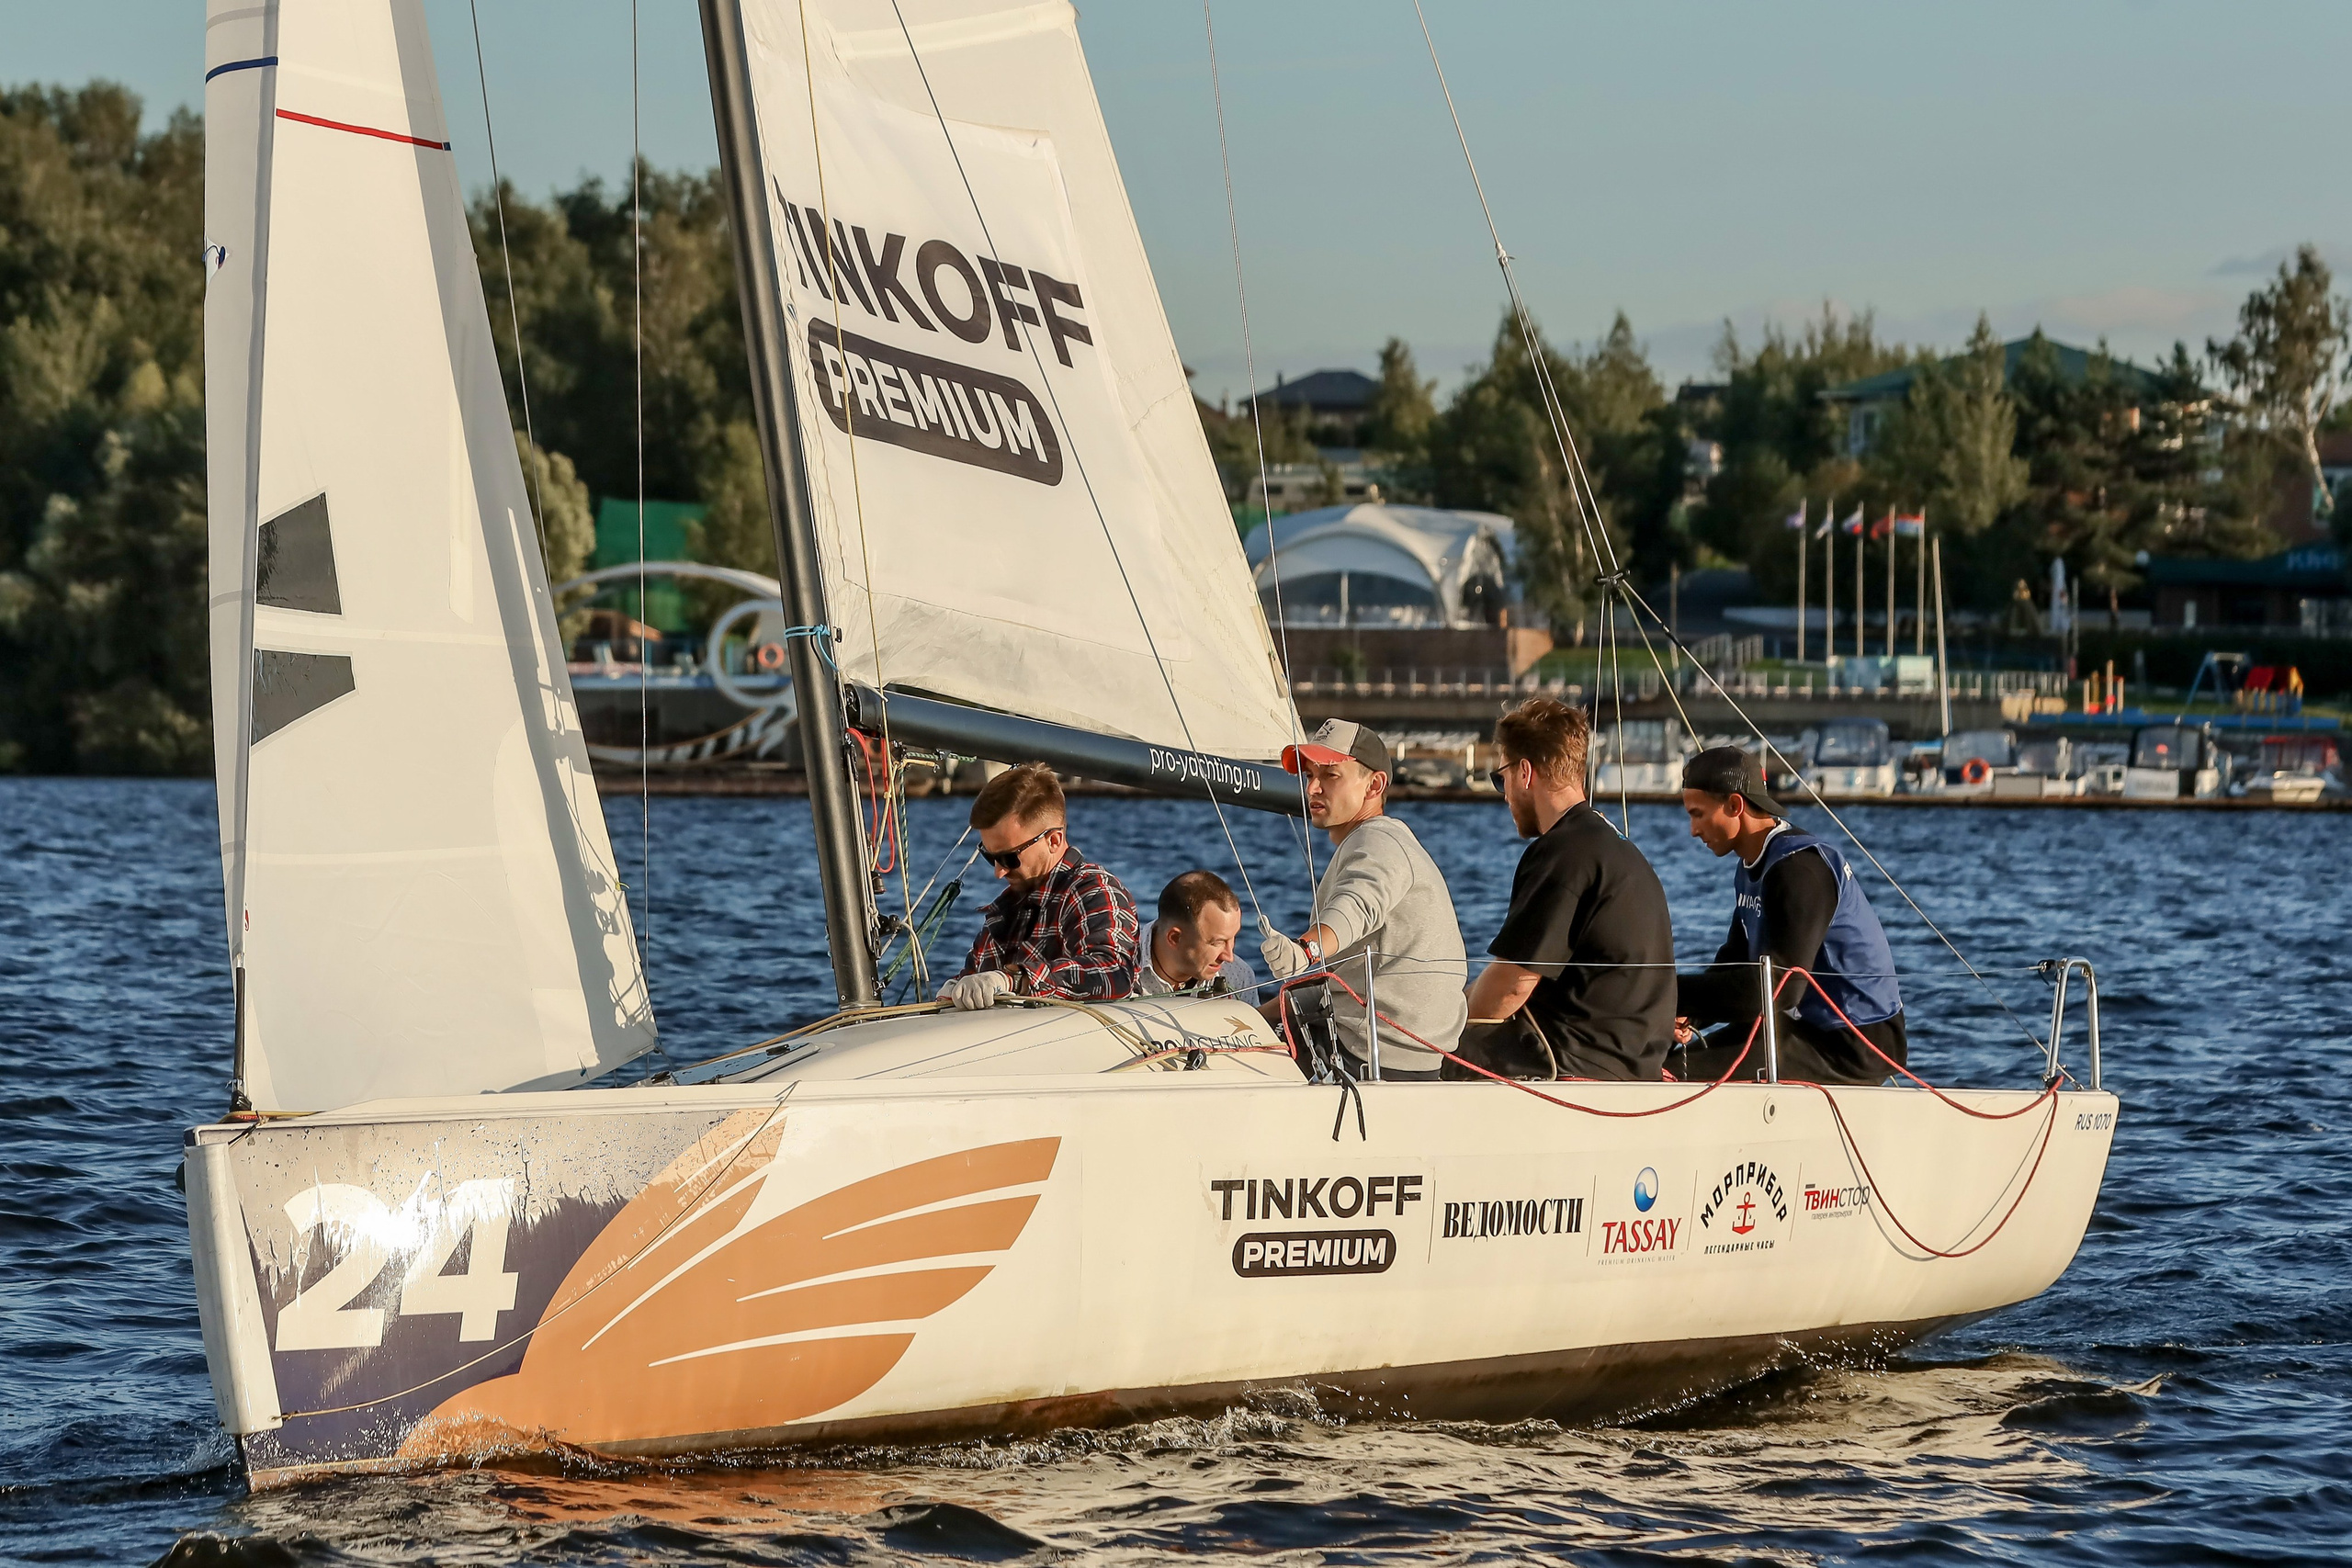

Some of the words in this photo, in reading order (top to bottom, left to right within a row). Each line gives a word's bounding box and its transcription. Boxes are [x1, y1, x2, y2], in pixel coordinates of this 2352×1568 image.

[818, 340, 1049, 464] PREMIUM
[1149, 747, 1261, 794] pro-yachting.ru
[2075, 1113, 2093, 1130] RUS
[2093, 1113, 2111, 1130] 1070
[1211, 1175, 1423, 1220] TINKOFF
[1700, 1161, 1787, 1229] МОРПРИБОР
[1442, 1198, 1584, 1242] ВЕДОМОСТИ
[1601, 1217, 1682, 1254] TASSAY
[276, 1179, 519, 1352] 24
[1242, 1237, 1387, 1269] PREMIUM
[1598, 1258, 1624, 1266] PREMIUM
[1704, 1243, 1754, 1255] ЛЕГЕНДАРНЫЕ
[1757, 1240, 1775, 1250] ЧАСЫ
